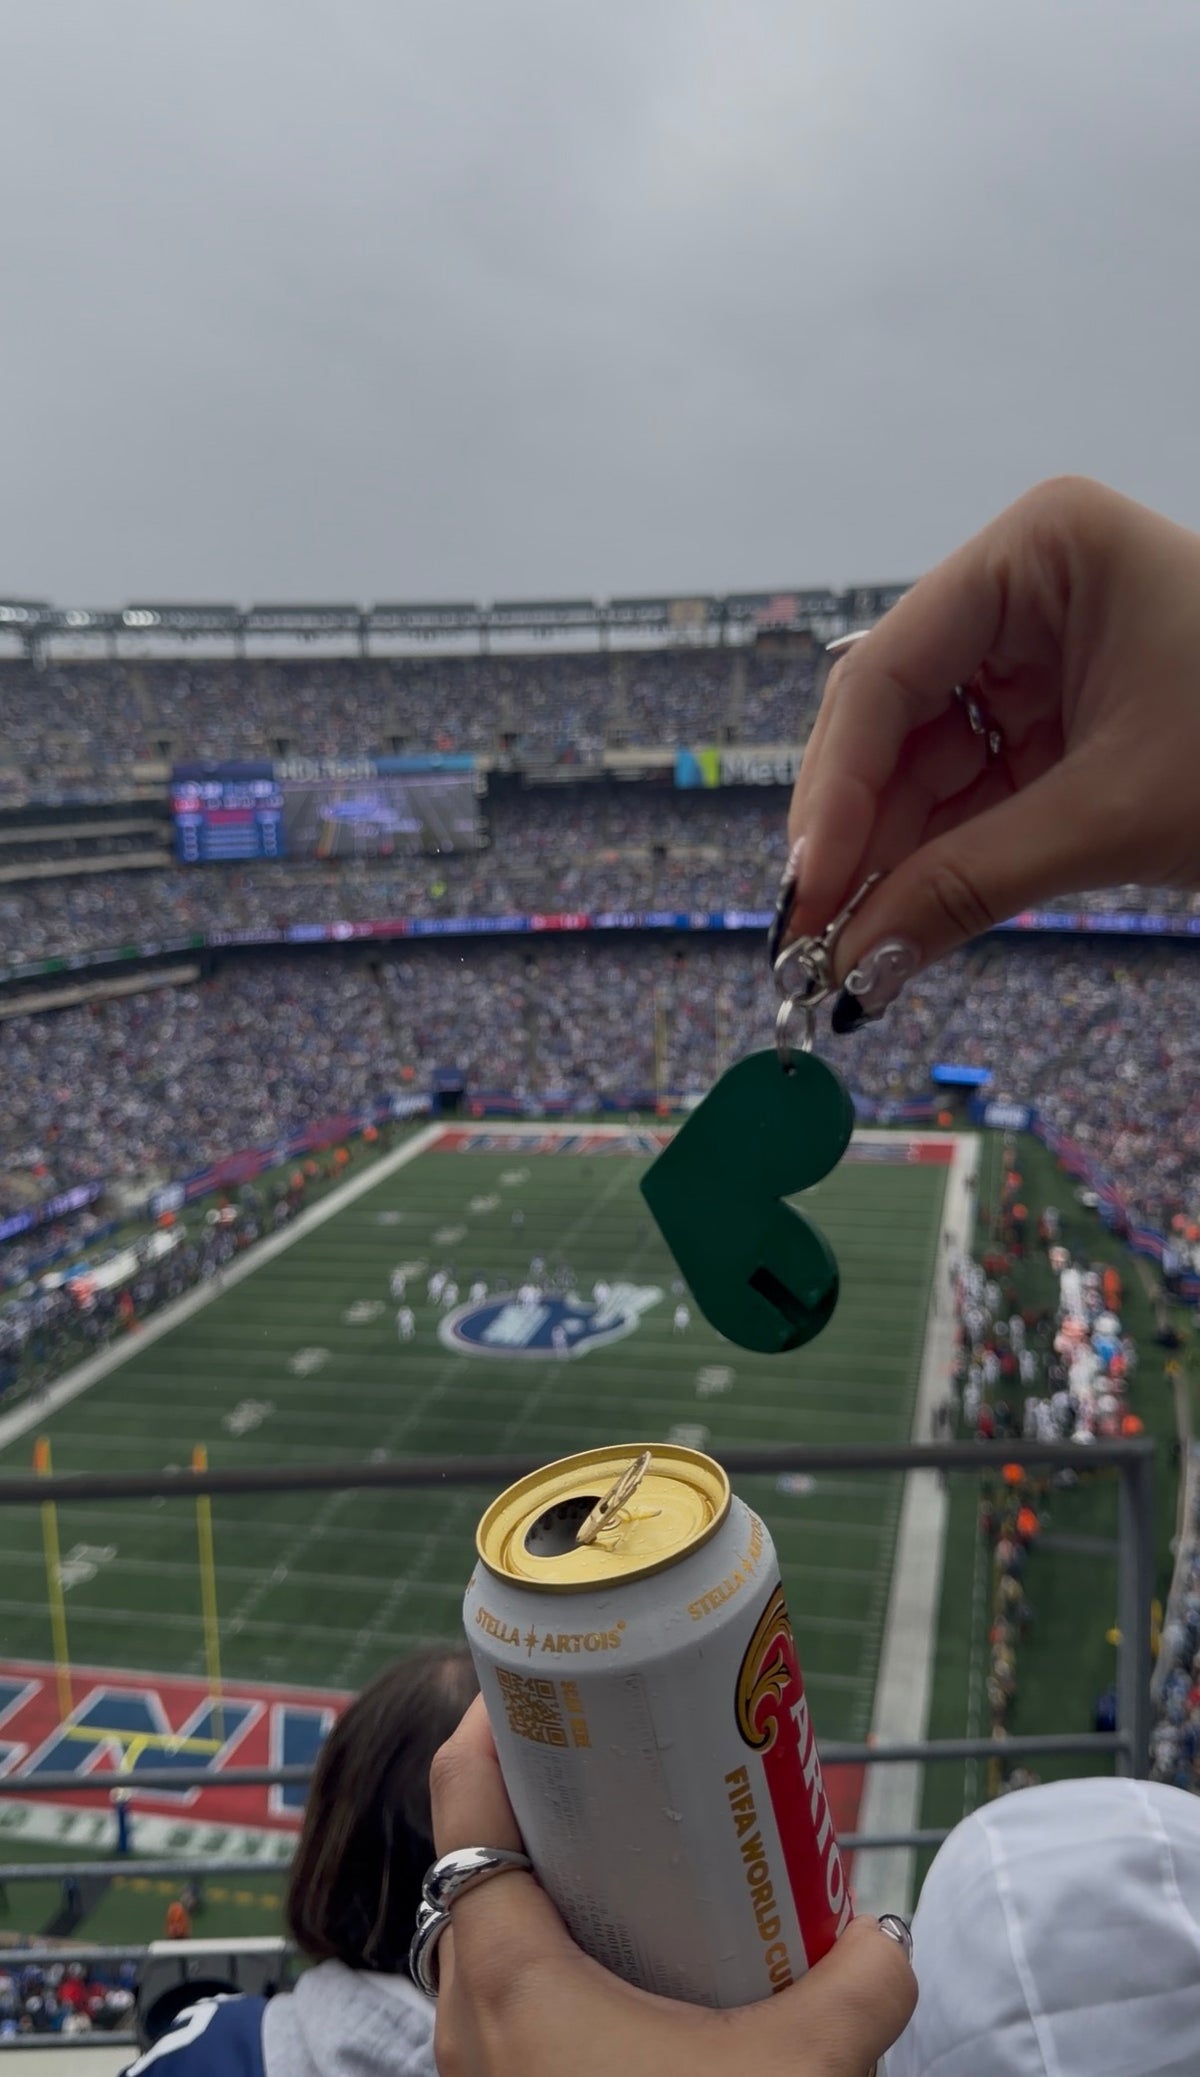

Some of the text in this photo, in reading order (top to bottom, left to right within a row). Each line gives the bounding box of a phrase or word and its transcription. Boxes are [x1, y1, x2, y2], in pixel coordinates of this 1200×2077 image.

[475, 1606, 622, 1654] STELLA ARTOIS
[686, 1568, 746, 1621] STELLA
[724, 1764, 756, 1839] FIFA
[740, 1829, 781, 1942] WORLD
[790, 1692, 854, 1940] ARTO
